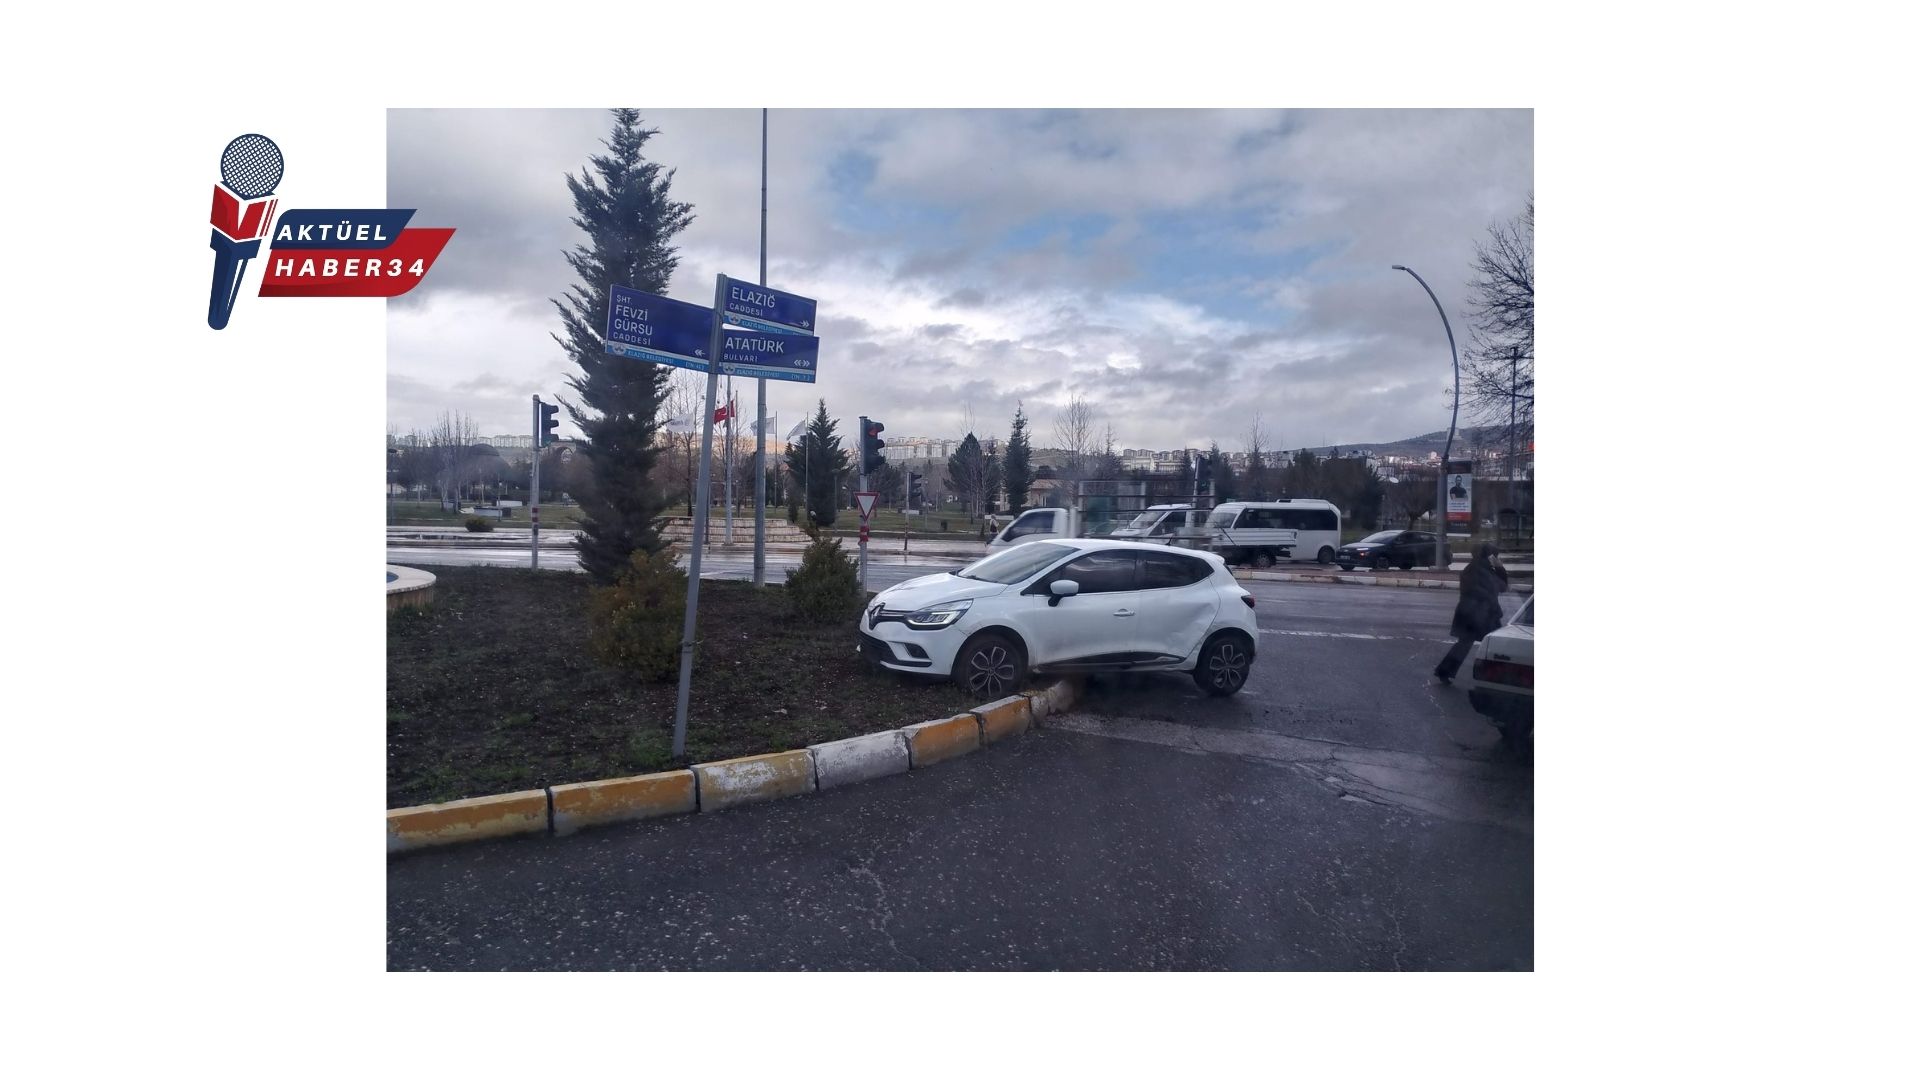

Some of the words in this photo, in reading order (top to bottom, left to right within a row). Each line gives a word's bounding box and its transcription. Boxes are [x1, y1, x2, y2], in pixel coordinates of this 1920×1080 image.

[732, 286, 775, 308] ELAZIĞ
[615, 304, 648, 321] FEVZİ
[614, 318, 653, 336] GÜRSU
[725, 337, 785, 354] ATATÜRK
